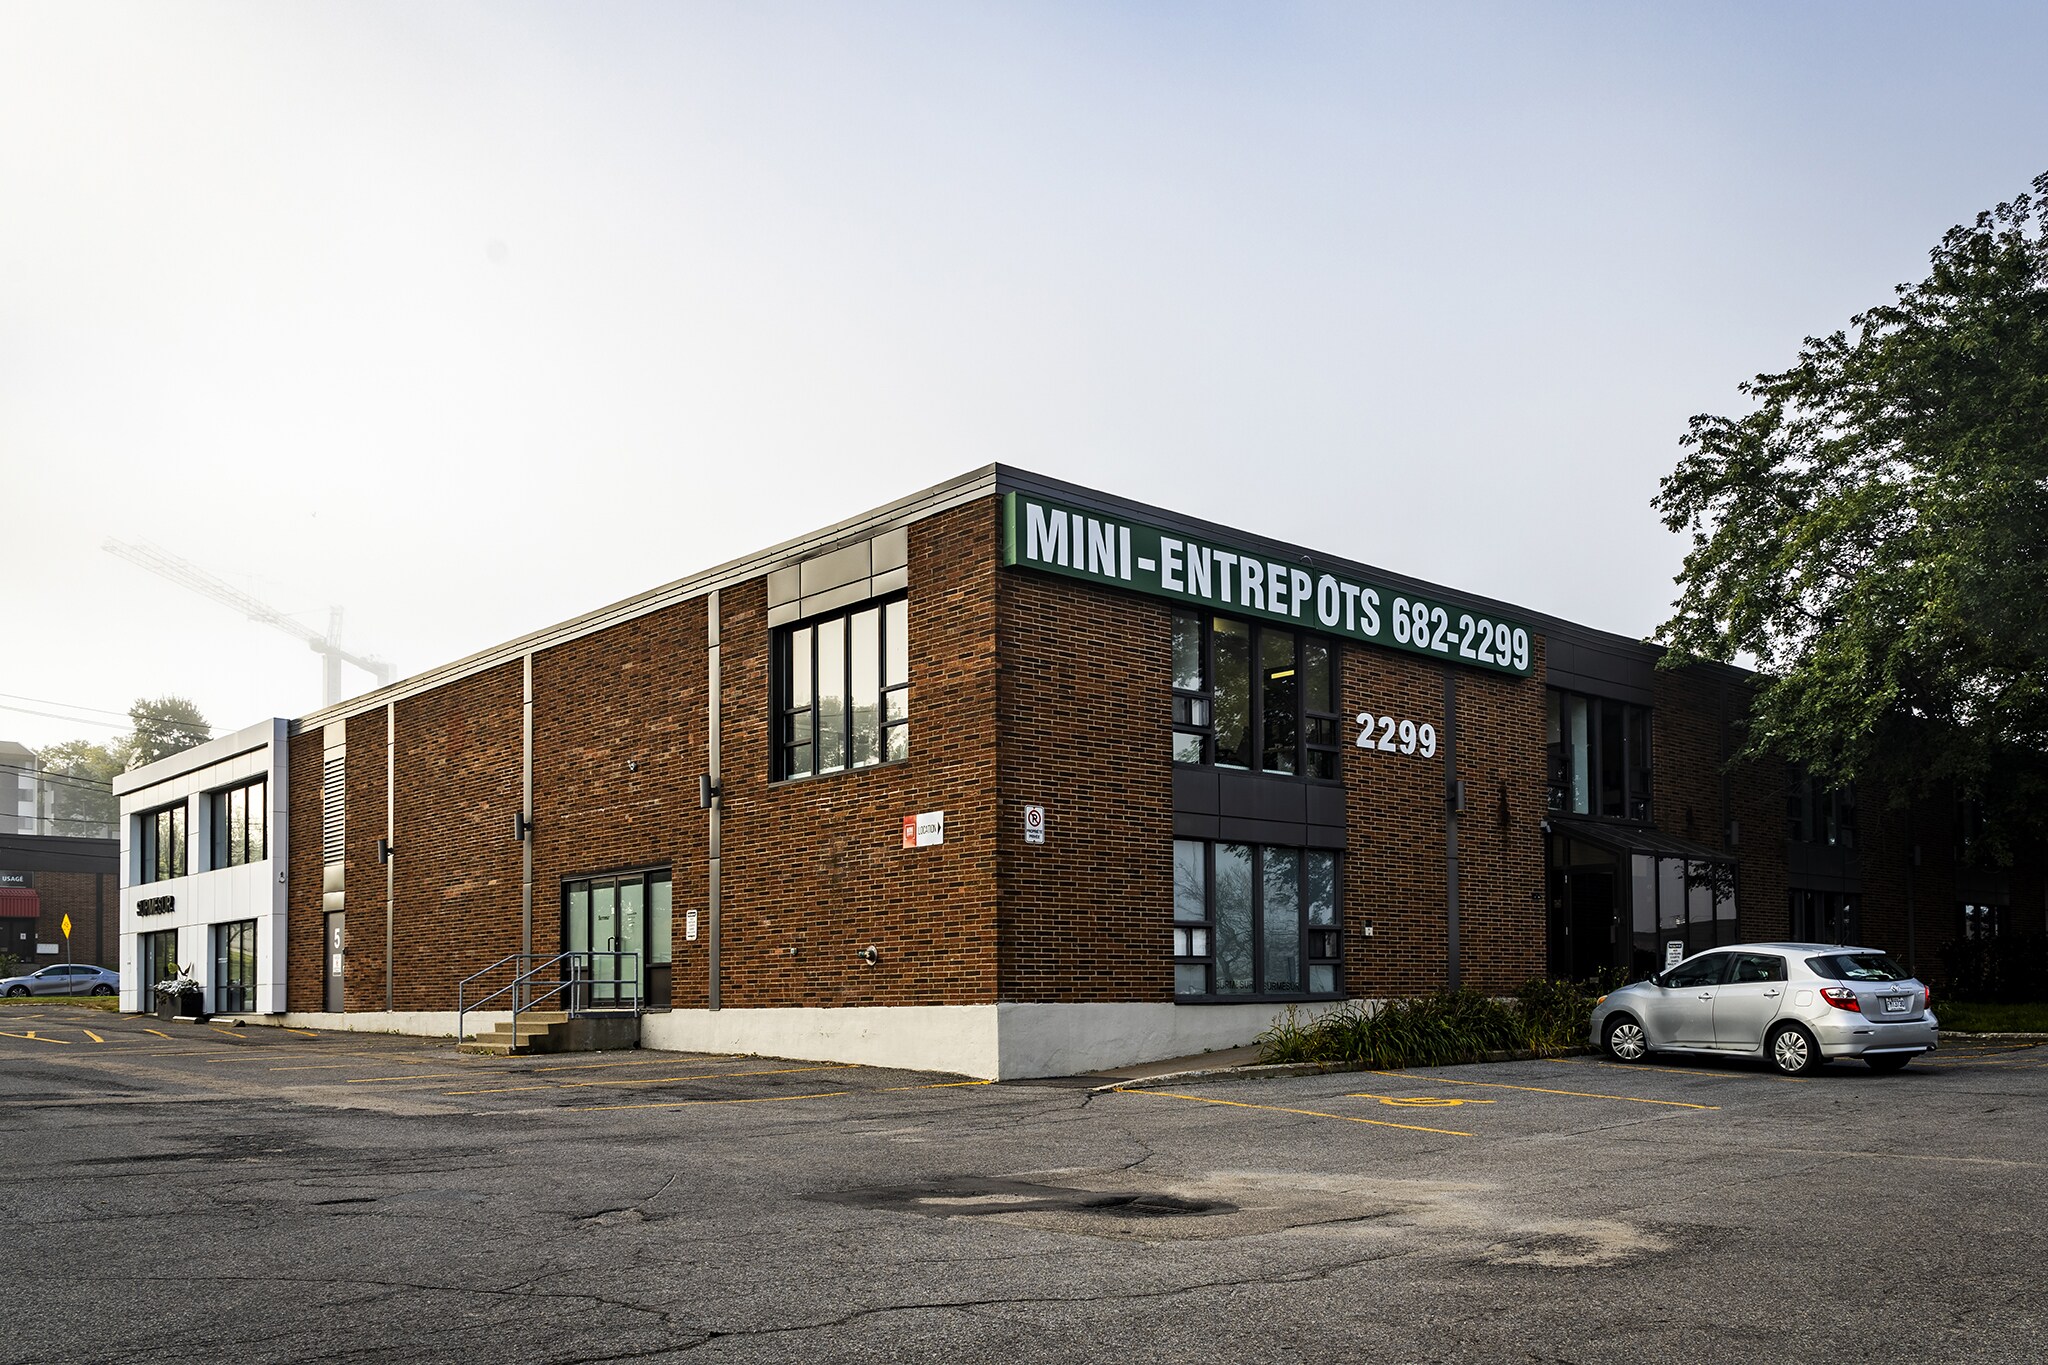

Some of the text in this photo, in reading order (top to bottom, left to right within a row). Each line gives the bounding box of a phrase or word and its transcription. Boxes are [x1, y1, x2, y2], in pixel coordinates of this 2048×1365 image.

[1392, 597, 1530, 671] 682-2299
[1356, 712, 1437, 758] 2299
[917, 823, 937, 836] LOCATION
[1, 875, 24, 883] USAGÉ
[136, 895, 176, 917] SURMESUR
[333, 927, 341, 949] 5
